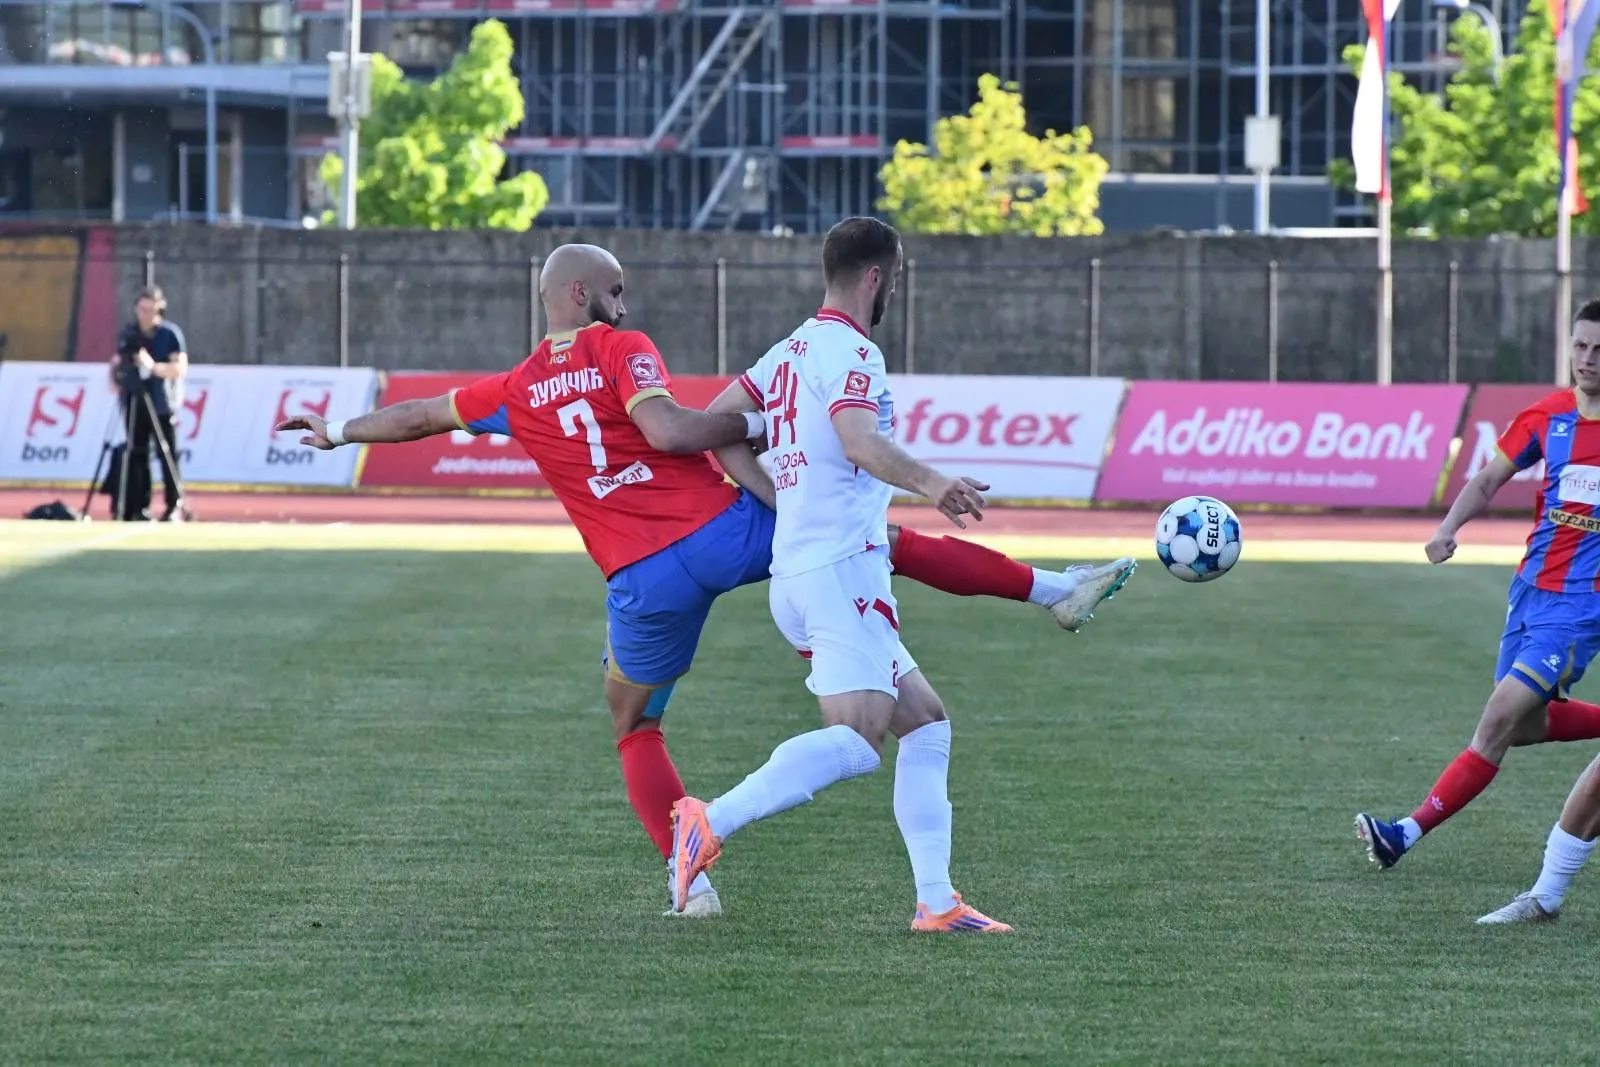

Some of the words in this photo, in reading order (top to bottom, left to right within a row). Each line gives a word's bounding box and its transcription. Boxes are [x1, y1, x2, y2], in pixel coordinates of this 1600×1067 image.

[527, 367, 604, 409] ЈУРИЧИЋ
[556, 398, 608, 474] 7
[892, 397, 1080, 447] fotex
[1129, 407, 1302, 457] Addiko
[1304, 410, 1436, 460] Bank
[22, 442, 70, 462] bon
[265, 446, 314, 465] bon
[1206, 504, 1220, 548] SELECT
[1551, 510, 1600, 531] MOZZART
